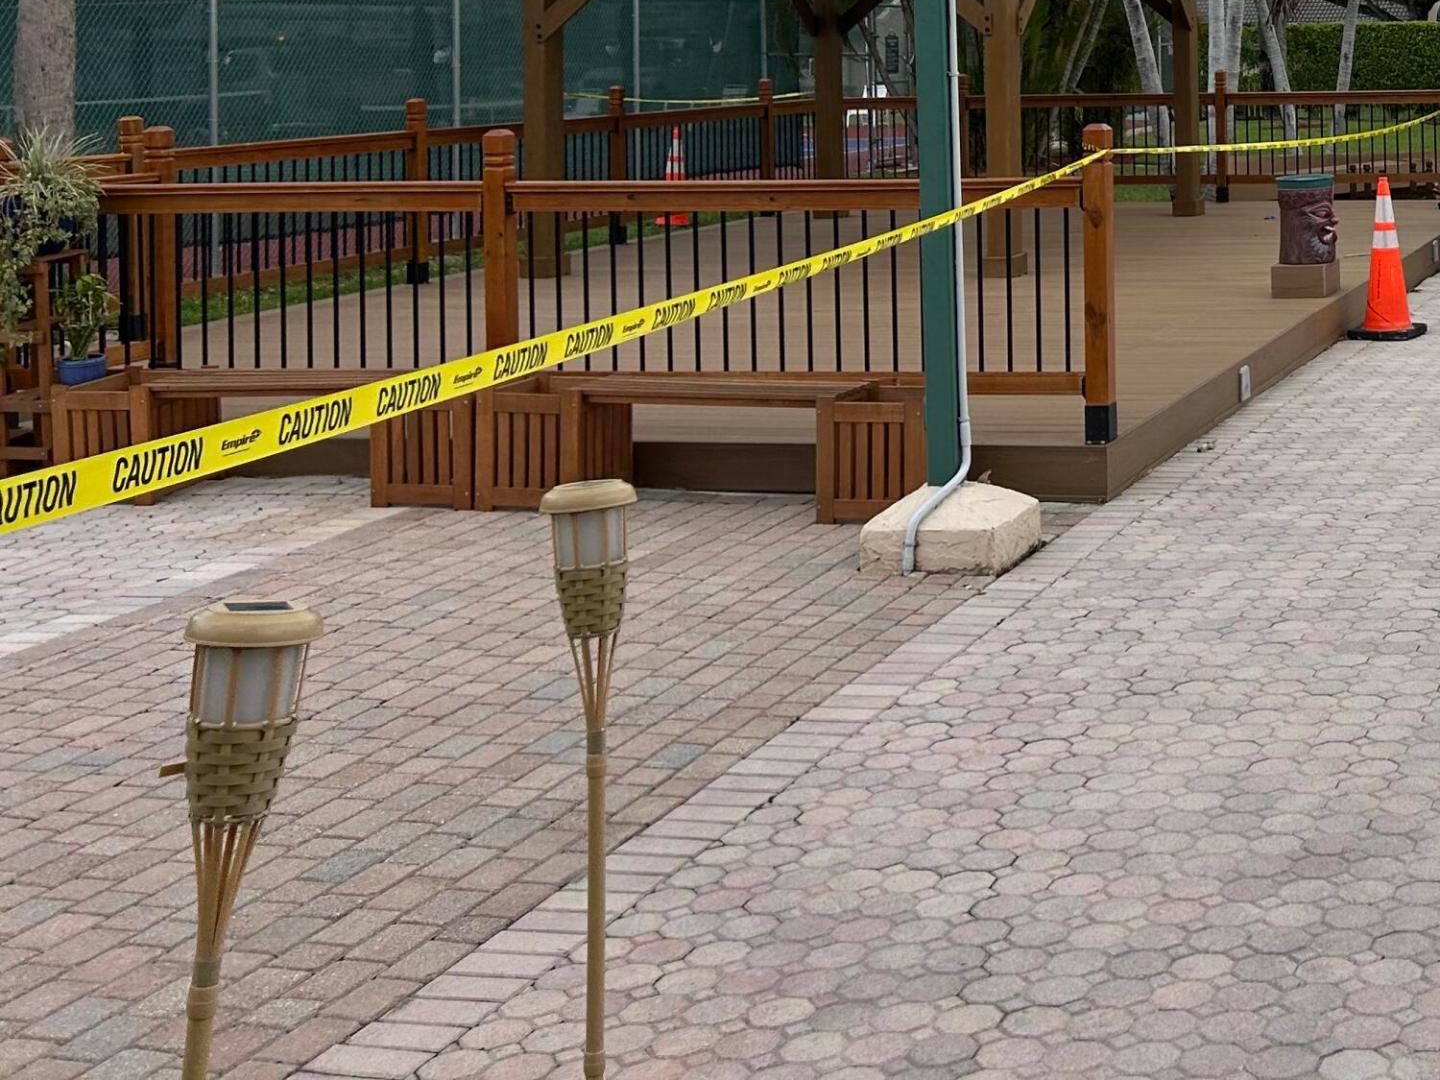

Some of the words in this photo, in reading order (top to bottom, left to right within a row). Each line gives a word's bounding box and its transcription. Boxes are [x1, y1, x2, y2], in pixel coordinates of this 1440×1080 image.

[0, 471, 76, 525] UTION
[113, 437, 203, 493] CAUTION
[221, 431, 259, 451] Empire
[278, 397, 352, 445] CAUTION
[376, 373, 441, 416] CAUTION
[493, 341, 548, 380] CAUTION
[564, 323, 614, 358] CAUTION
[651, 298, 696, 329] CAUTION
[706, 283, 747, 312] CAUTION
[778, 263, 811, 286] CAUTION
[821, 250, 852, 270] CAUTION
